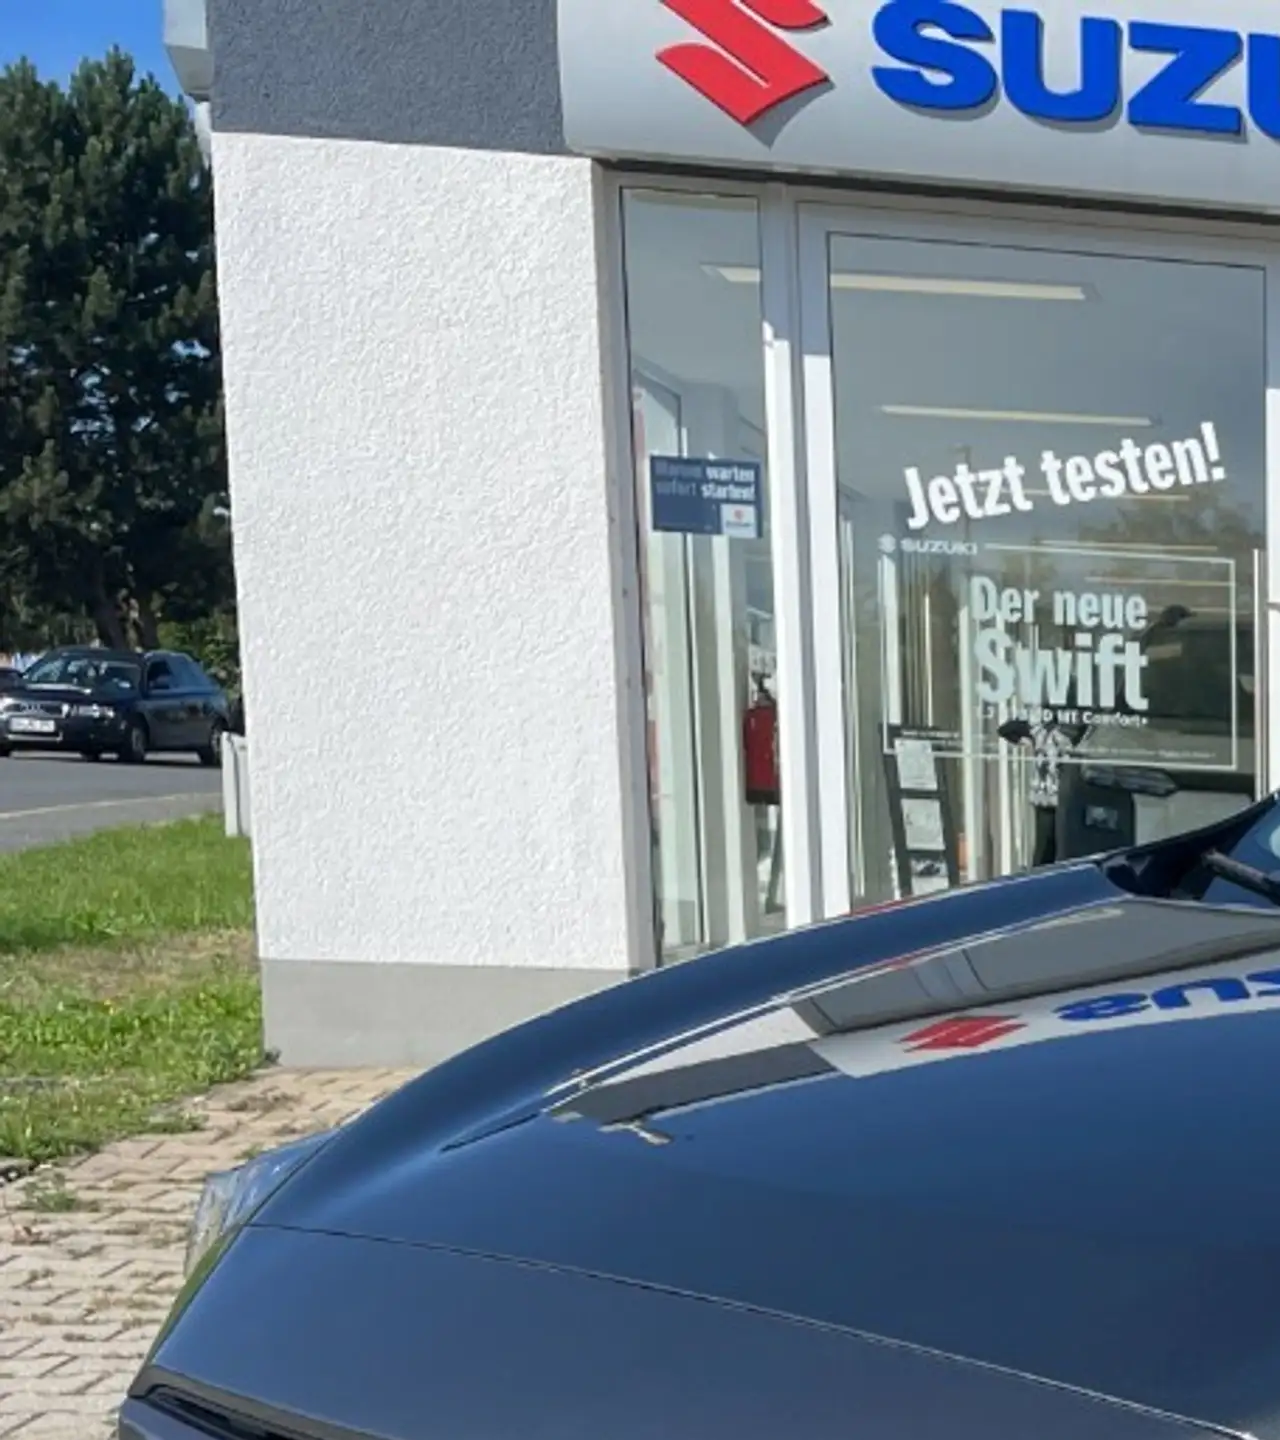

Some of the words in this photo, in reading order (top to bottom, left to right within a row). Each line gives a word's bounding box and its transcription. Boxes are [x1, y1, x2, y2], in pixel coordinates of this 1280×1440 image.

[705, 465, 755, 481] warten
[904, 456, 1033, 529] Jetzt
[1041, 421, 1226, 506] testen!
[900, 537, 978, 556] SUZUKI
[970, 575, 1040, 624] Der
[1053, 590, 1148, 630] neue
[973, 627, 1150, 710] Swift
